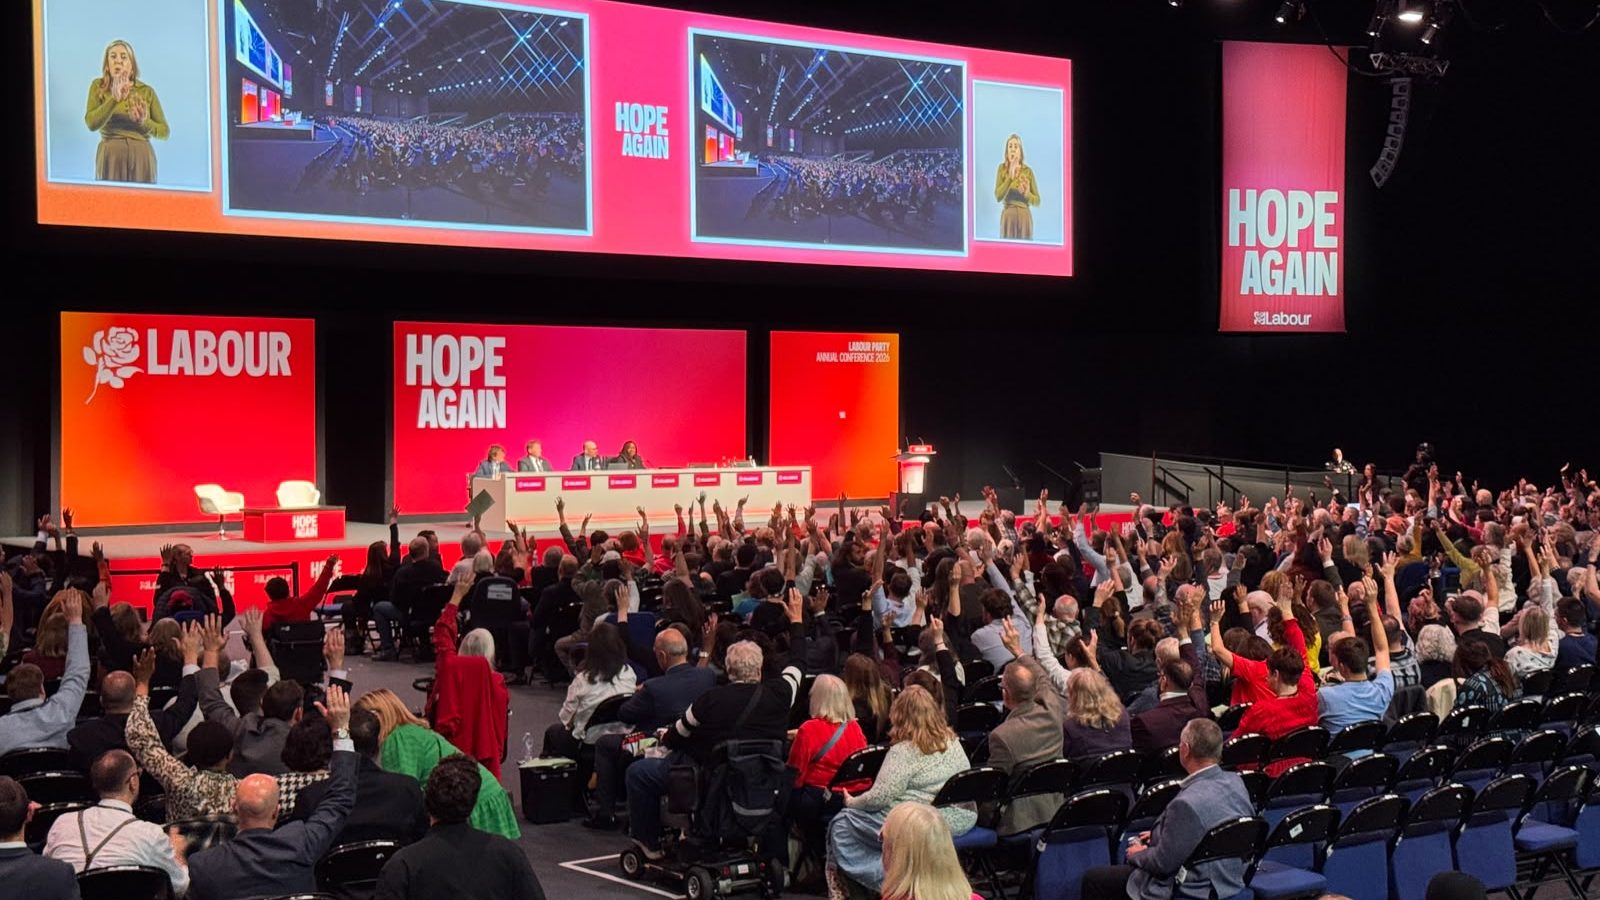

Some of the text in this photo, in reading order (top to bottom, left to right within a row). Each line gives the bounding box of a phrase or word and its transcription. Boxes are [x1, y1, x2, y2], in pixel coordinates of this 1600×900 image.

[615, 102, 669, 136] HOPE
[622, 133, 669, 159] AGAIN
[1228, 188, 1338, 249] HOPE
[1240, 250, 1338, 296] AGAIN
[1265, 311, 1312, 326] Labour
[147, 328, 292, 377] LABOUR
[406, 333, 507, 387] HOPE
[816, 352, 890, 362] ANNUAL CONFERENCE 2026
[848, 341, 890, 352] LABOUR PARTY
[416, 388, 507, 429] AGAIN
[292, 514, 319, 529] HOPE
[295, 528, 319, 538] AGAIN
